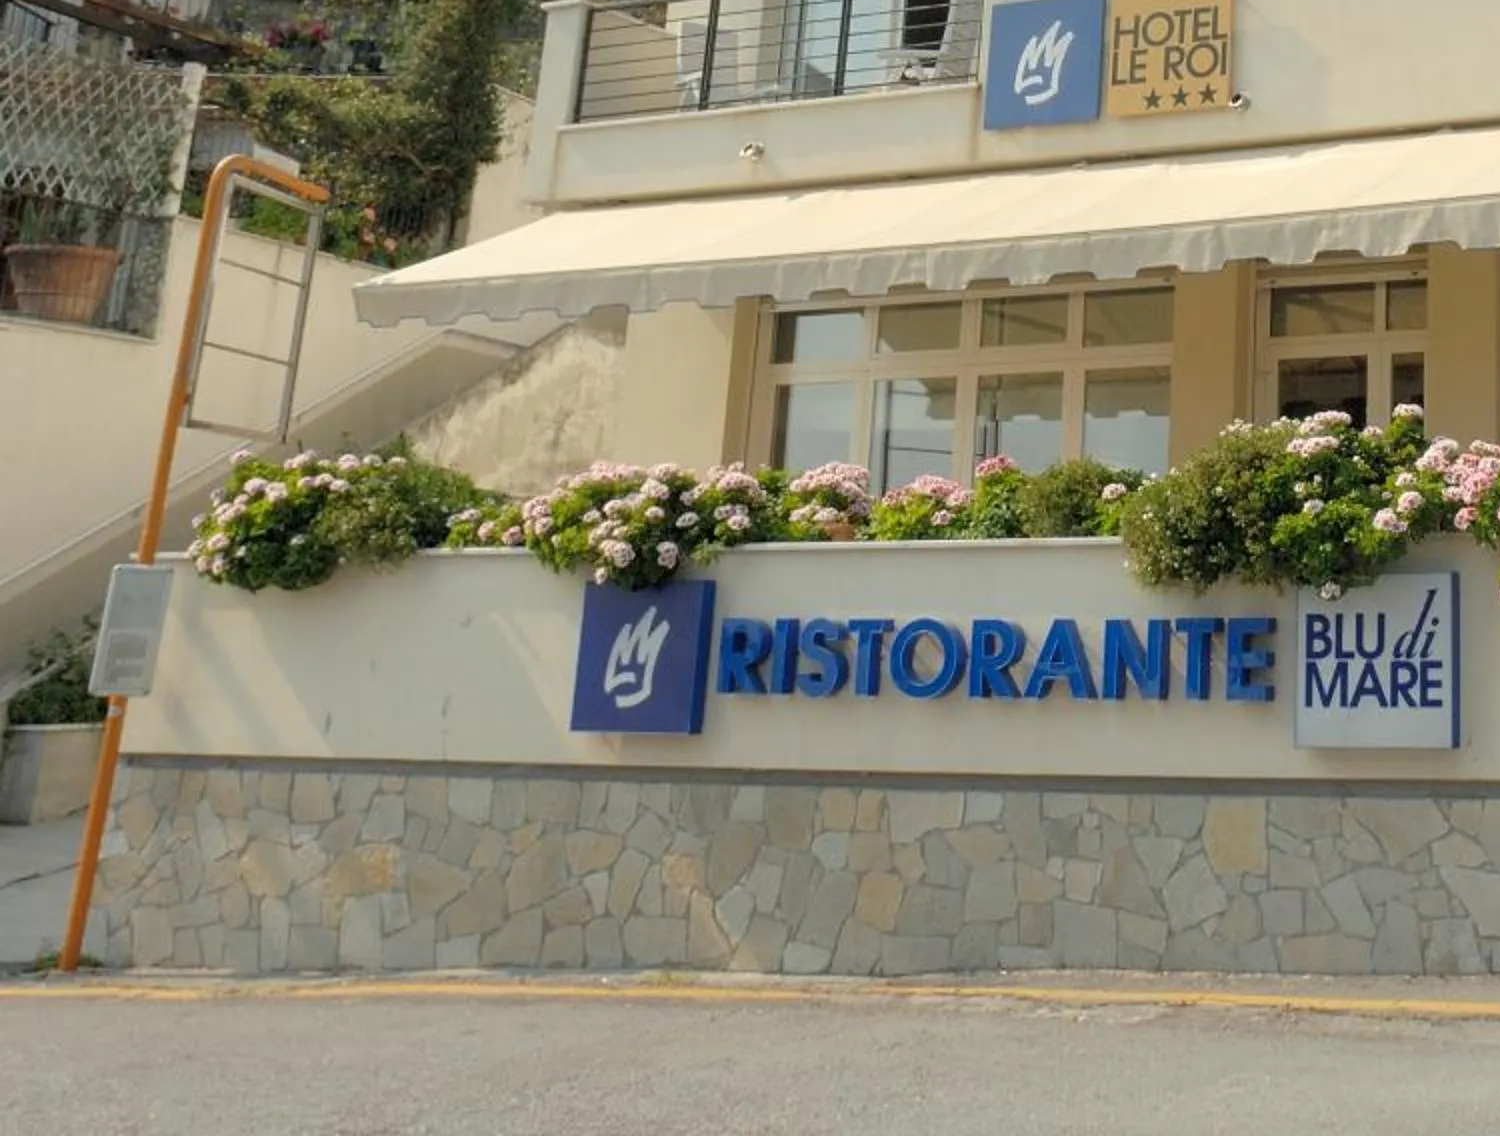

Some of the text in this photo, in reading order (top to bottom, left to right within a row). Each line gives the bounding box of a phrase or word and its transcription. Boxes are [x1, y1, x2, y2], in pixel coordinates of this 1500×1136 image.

[1113, 6, 1228, 49] HOTEL
[1111, 43, 1227, 86] LE ROI
[1305, 589, 1439, 660] BLU di
[716, 616, 1277, 702] RISTORANTE
[1305, 660, 1443, 708] MARE
